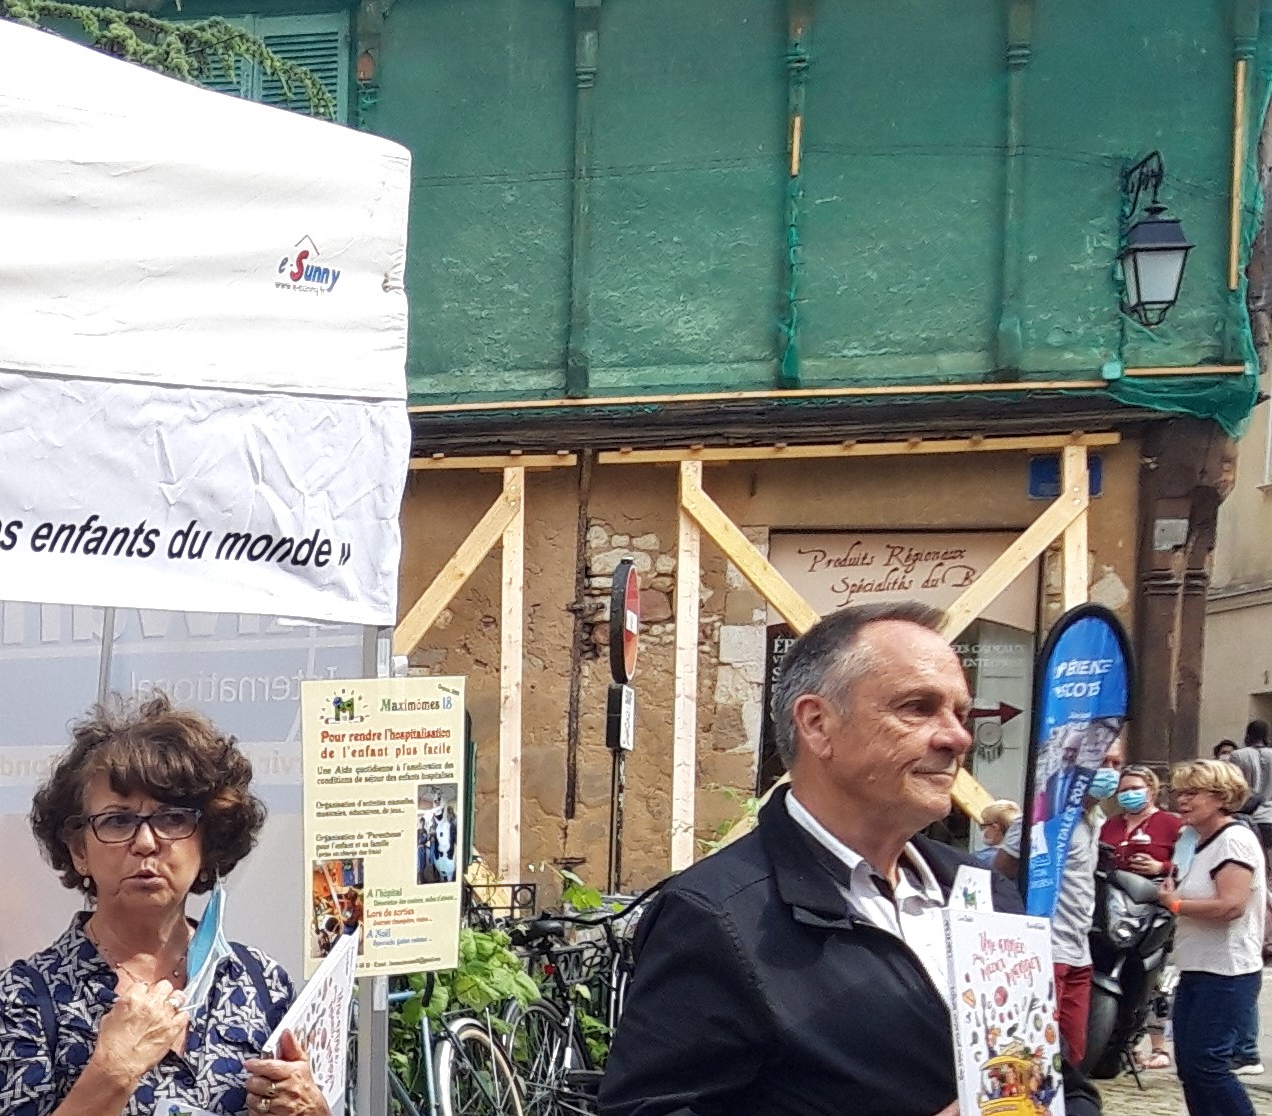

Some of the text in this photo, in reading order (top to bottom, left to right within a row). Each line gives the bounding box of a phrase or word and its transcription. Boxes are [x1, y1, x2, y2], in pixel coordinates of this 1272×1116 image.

[30, 515, 161, 560] enfants
[167, 517, 212, 560] du
[215, 529, 333, 568] monde
[798, 540, 875, 573] Produits
[831, 568, 914, 607] Spécialités
[442, 696, 453, 710] 18
[320, 730, 346, 743] Pour
[348, 729, 382, 741] rendre
[320, 742, 452, 759] de l'enfant plus facile
